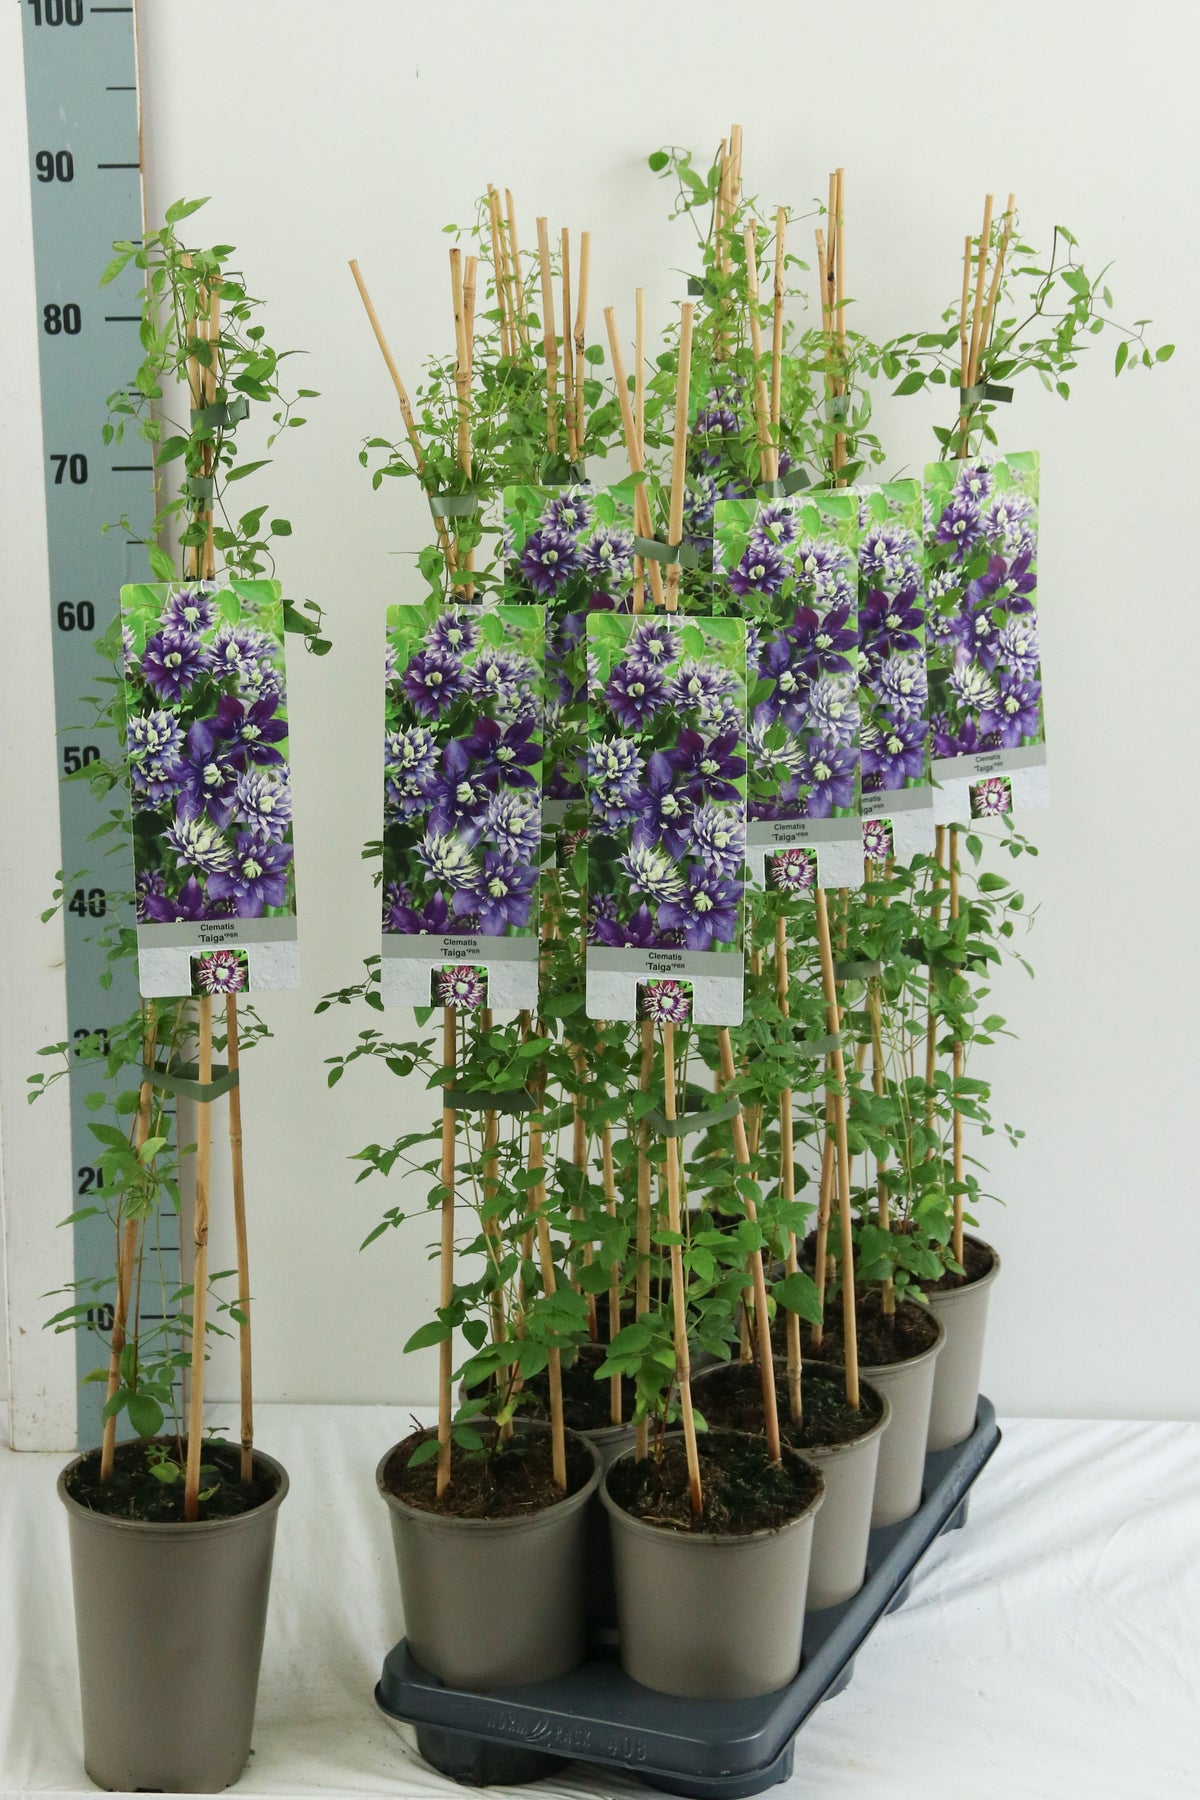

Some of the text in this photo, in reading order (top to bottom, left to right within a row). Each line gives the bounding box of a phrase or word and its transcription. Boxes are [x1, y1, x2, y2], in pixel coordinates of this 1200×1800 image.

[28, 0, 84, 27] 100
[36, 150, 74, 182] 90
[43, 303, 82, 335] 80
[50, 453, 89, 485] 70
[57, 600, 95, 631] 60
[975, 754, 1001, 763] Clematis
[774, 823, 806, 831] Clematis
[69, 888, 107, 918] 40
[200, 923, 235, 932] Clematis
[443, 938, 478, 947] Clematis
[648, 952, 683, 961] Clematis
